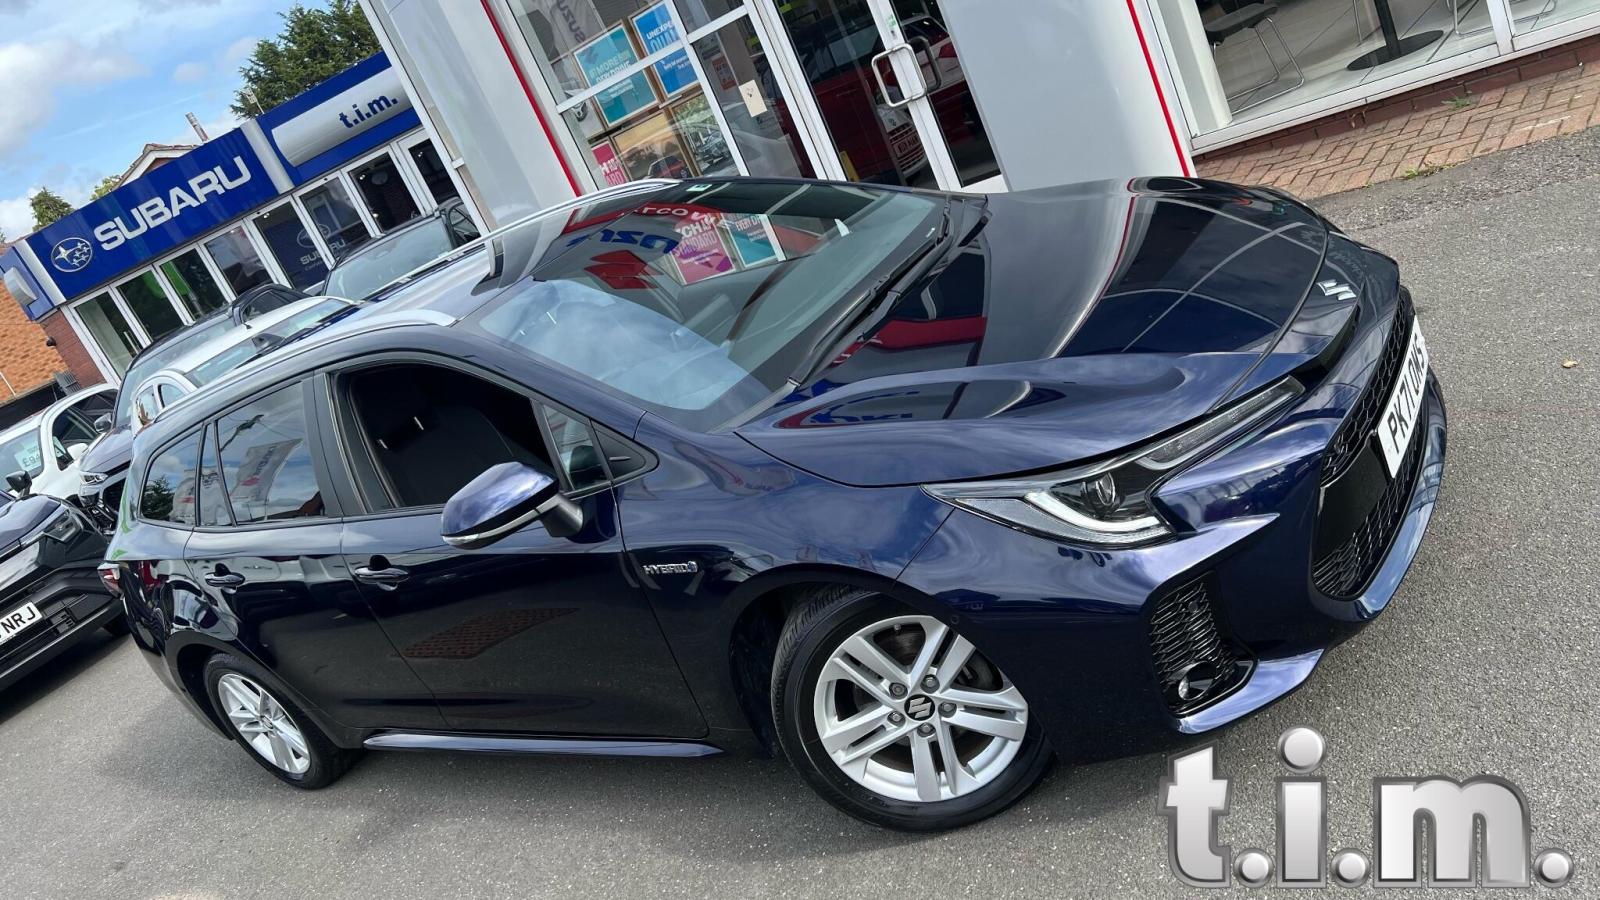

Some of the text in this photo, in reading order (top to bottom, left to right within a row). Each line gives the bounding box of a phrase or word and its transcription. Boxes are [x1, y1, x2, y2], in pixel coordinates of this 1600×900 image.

[339, 94, 398, 129] t.i.m.
[93, 155, 251, 251] SUBARU
[642, 563, 688, 575] HYBRID
[1, 606, 36, 634] NRJ
